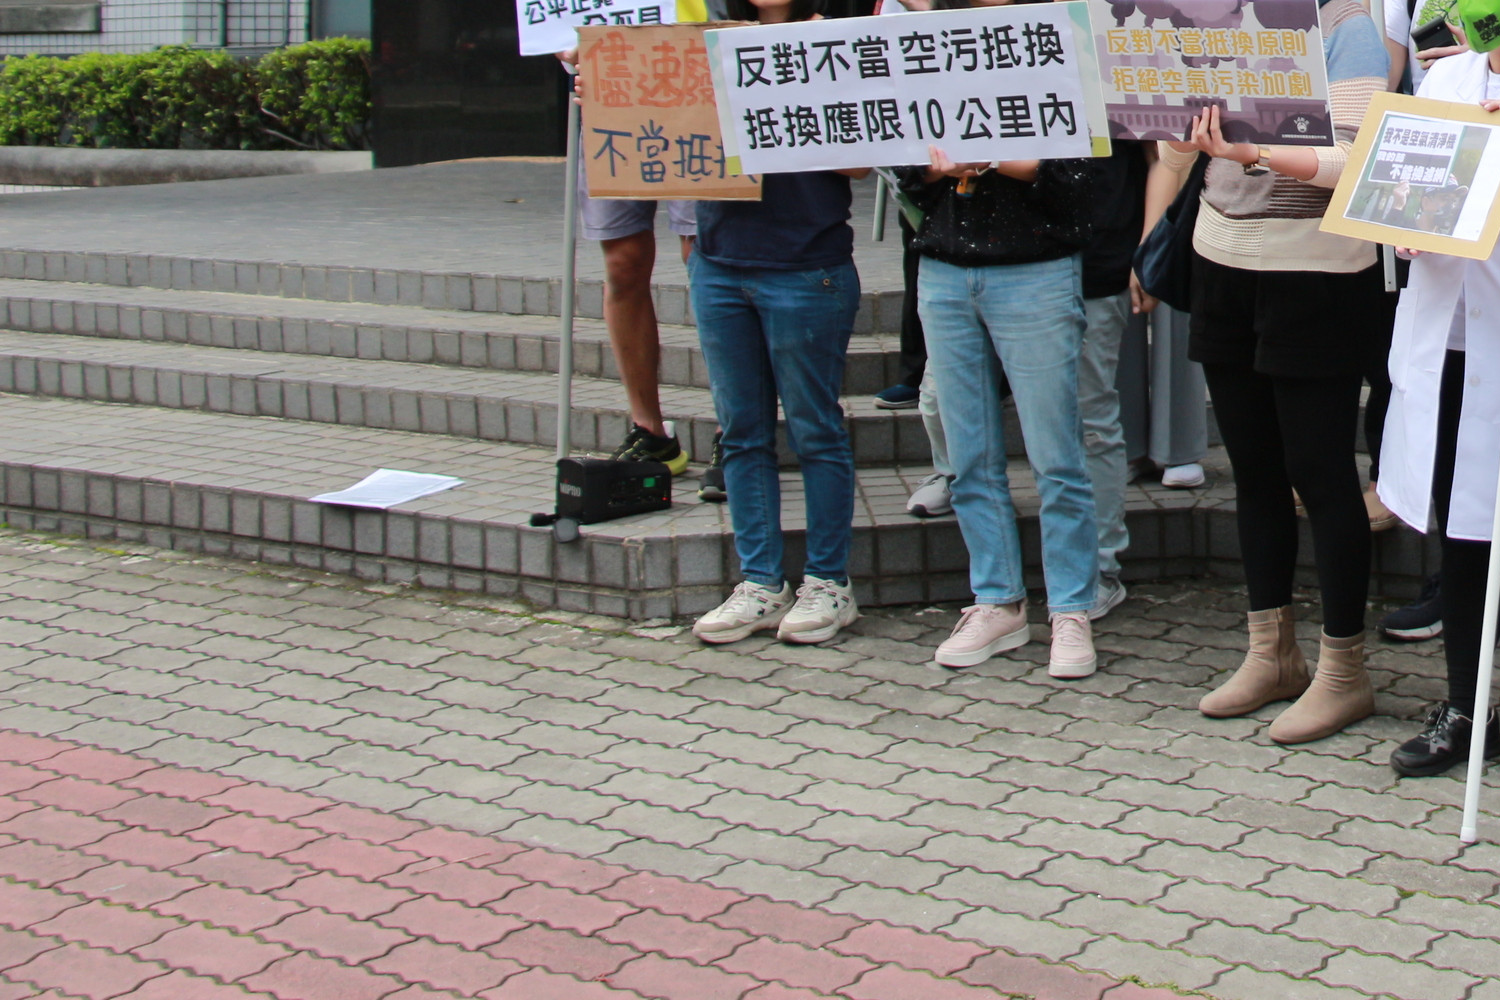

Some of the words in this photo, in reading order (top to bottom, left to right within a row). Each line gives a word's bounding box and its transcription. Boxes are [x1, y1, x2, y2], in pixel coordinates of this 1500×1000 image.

[734, 22, 1065, 88] 反對不當空污抵換
[1106, 28, 1308, 57] 反對不當抵換原則
[1112, 67, 1313, 97] 拒絕空氣污染加劇
